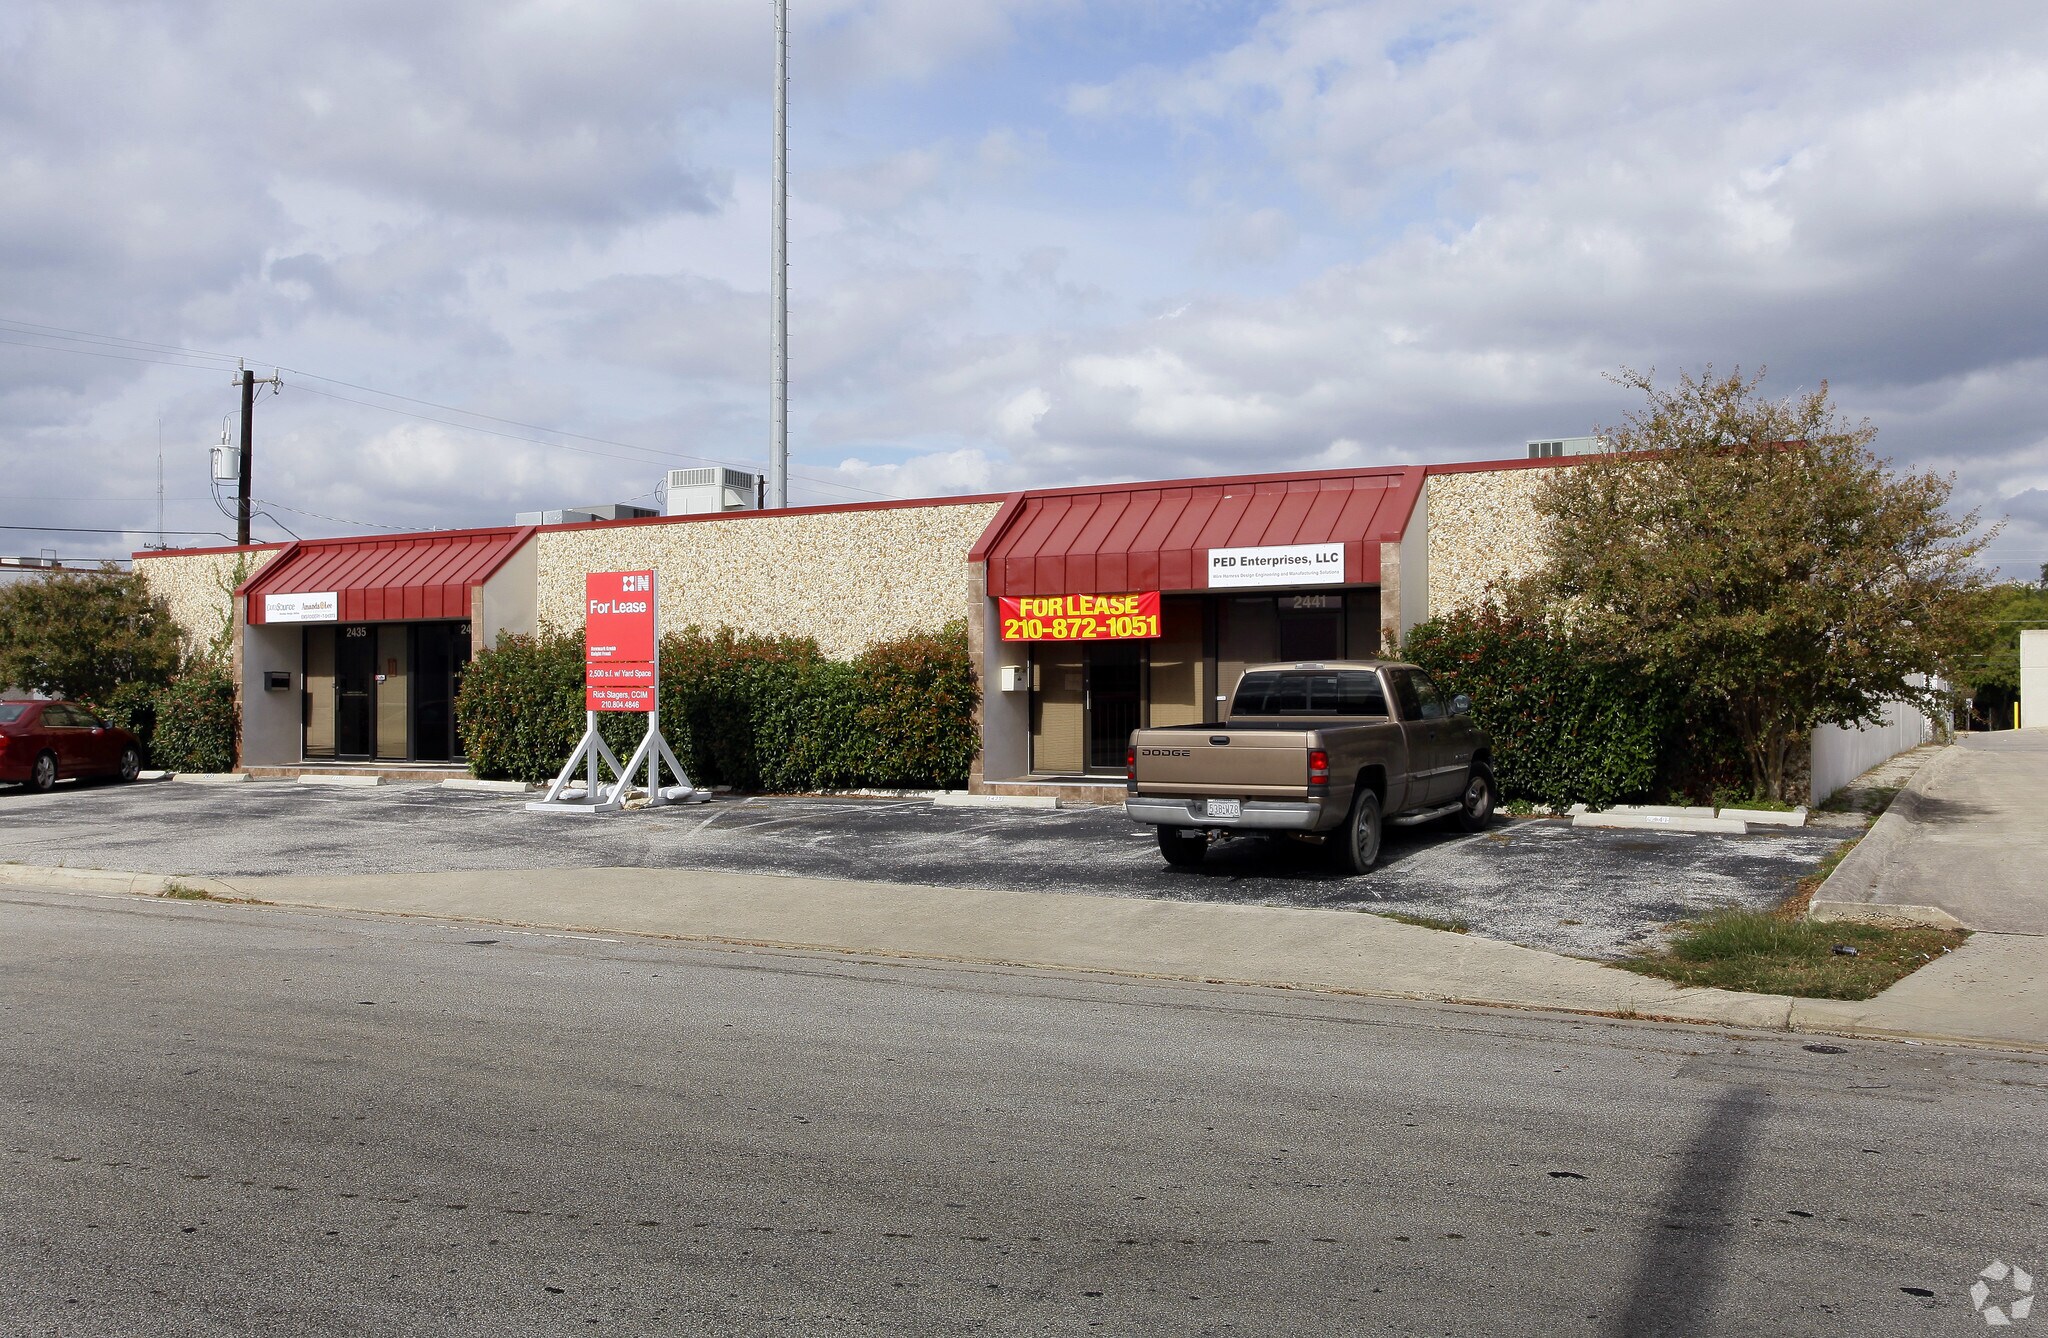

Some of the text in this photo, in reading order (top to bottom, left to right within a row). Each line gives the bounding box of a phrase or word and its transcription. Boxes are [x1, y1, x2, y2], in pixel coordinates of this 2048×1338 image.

[1213, 553, 1339, 567] PED Enterprises, LLC
[590, 600, 646, 614] For Lease
[1020, 594, 1139, 616] FOR LEASE
[1294, 594, 1327, 608] 2441
[346, 627, 366, 637] 2435
[461, 624, 470, 634] 24
[1004, 615, 1157, 638] 210-872-1051
[634, 670, 652, 678] Space
